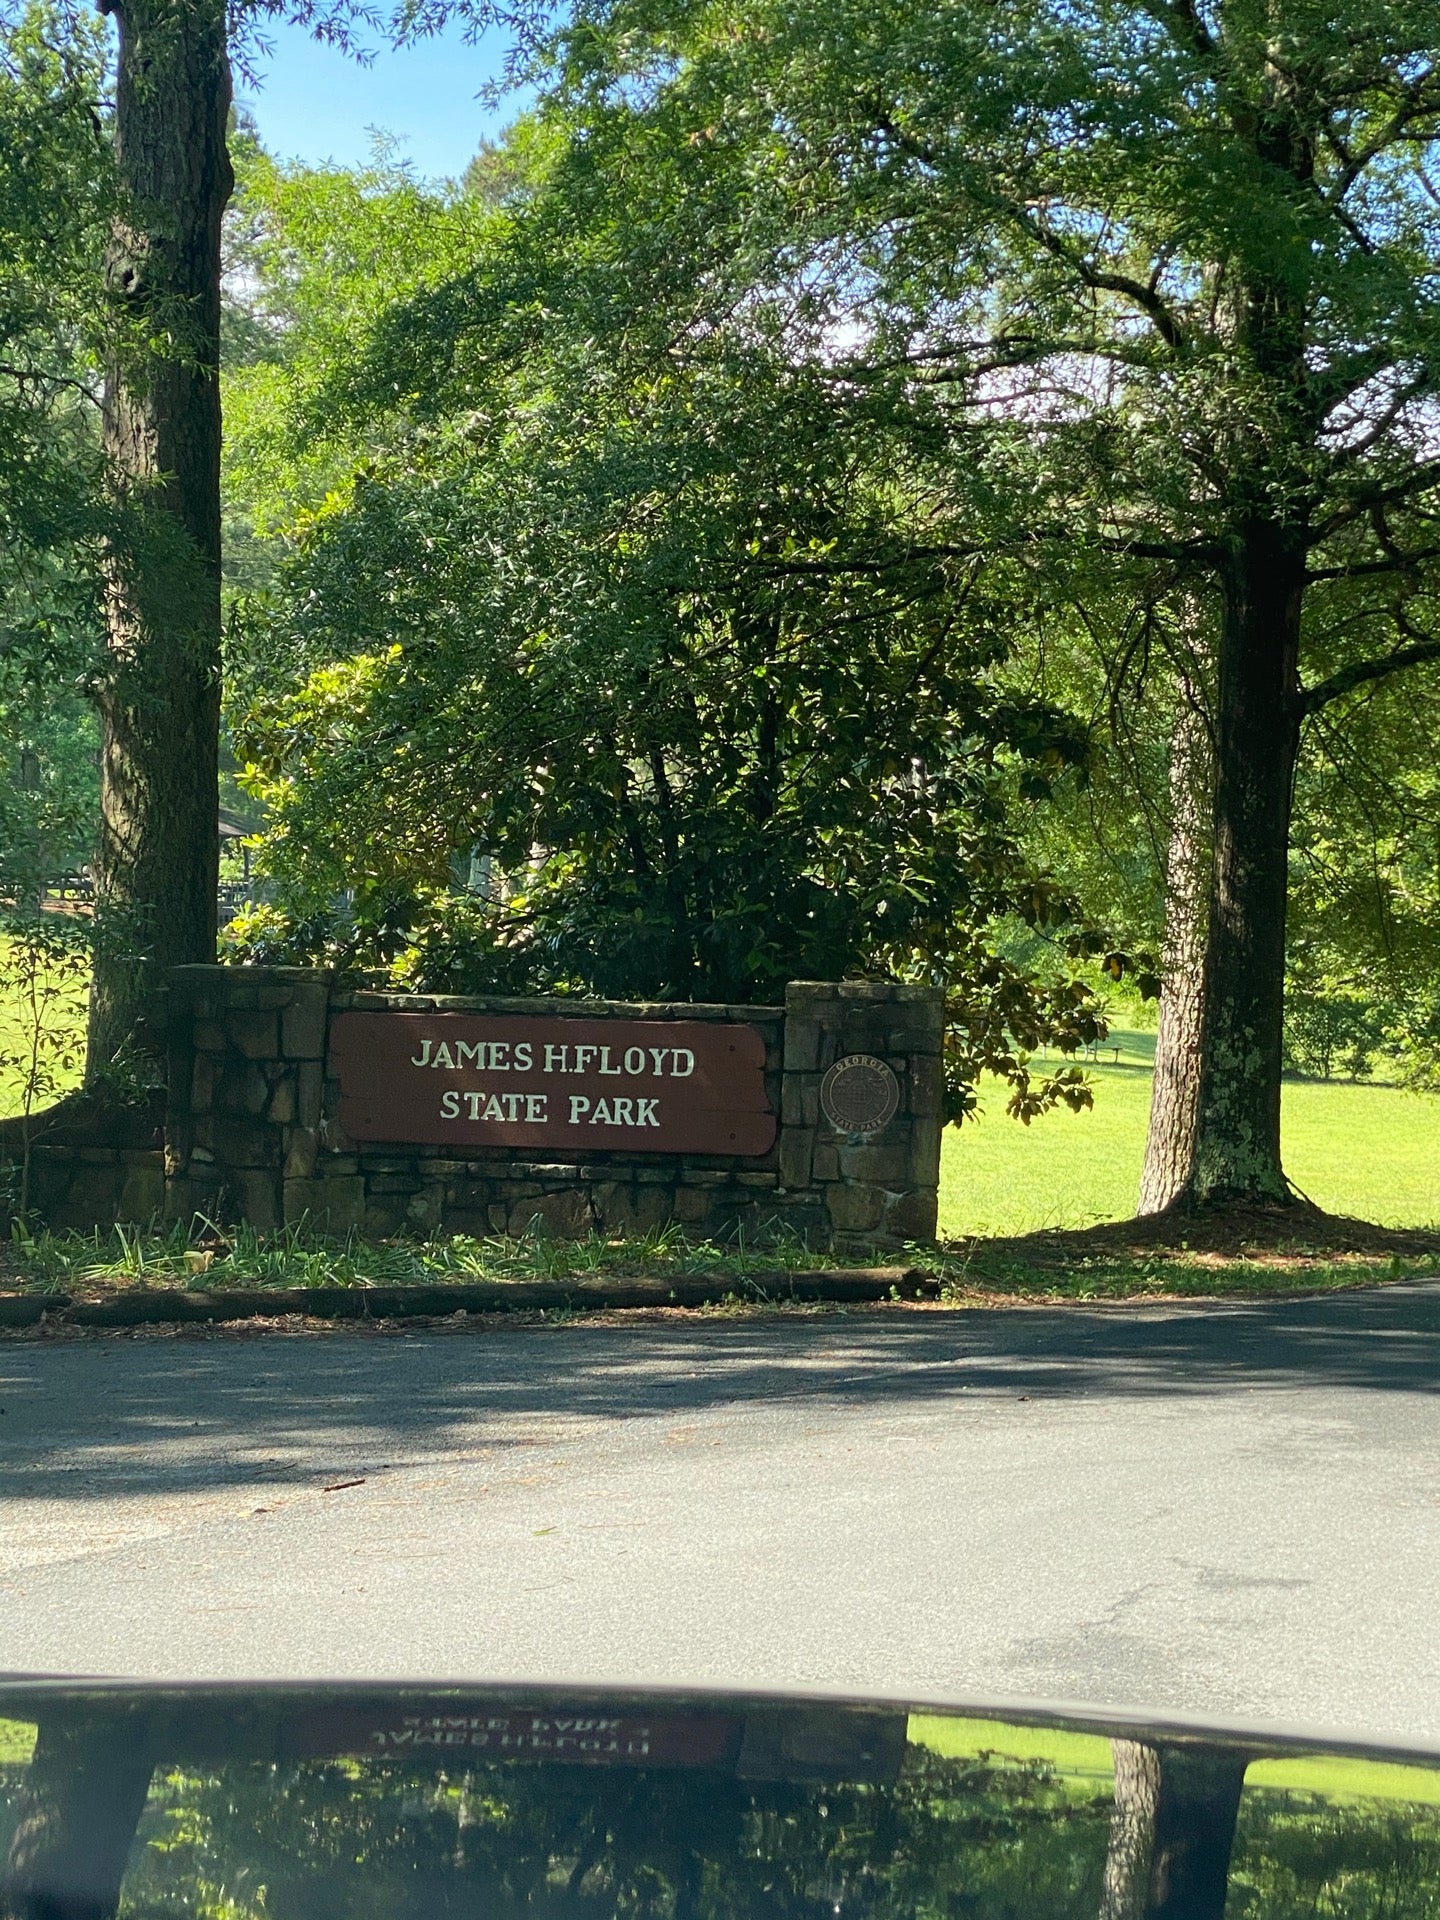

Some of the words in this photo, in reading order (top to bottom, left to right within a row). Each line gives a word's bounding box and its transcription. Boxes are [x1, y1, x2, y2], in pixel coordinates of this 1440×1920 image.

[411, 1039, 533, 1071] JAMES
[836, 1057, 889, 1076] GEORGIA
[439, 1090, 548, 1123] STATE
[568, 1094, 661, 1127] PARK
[831, 1112, 854, 1130] STATE
[861, 1119, 882, 1131] PARK
